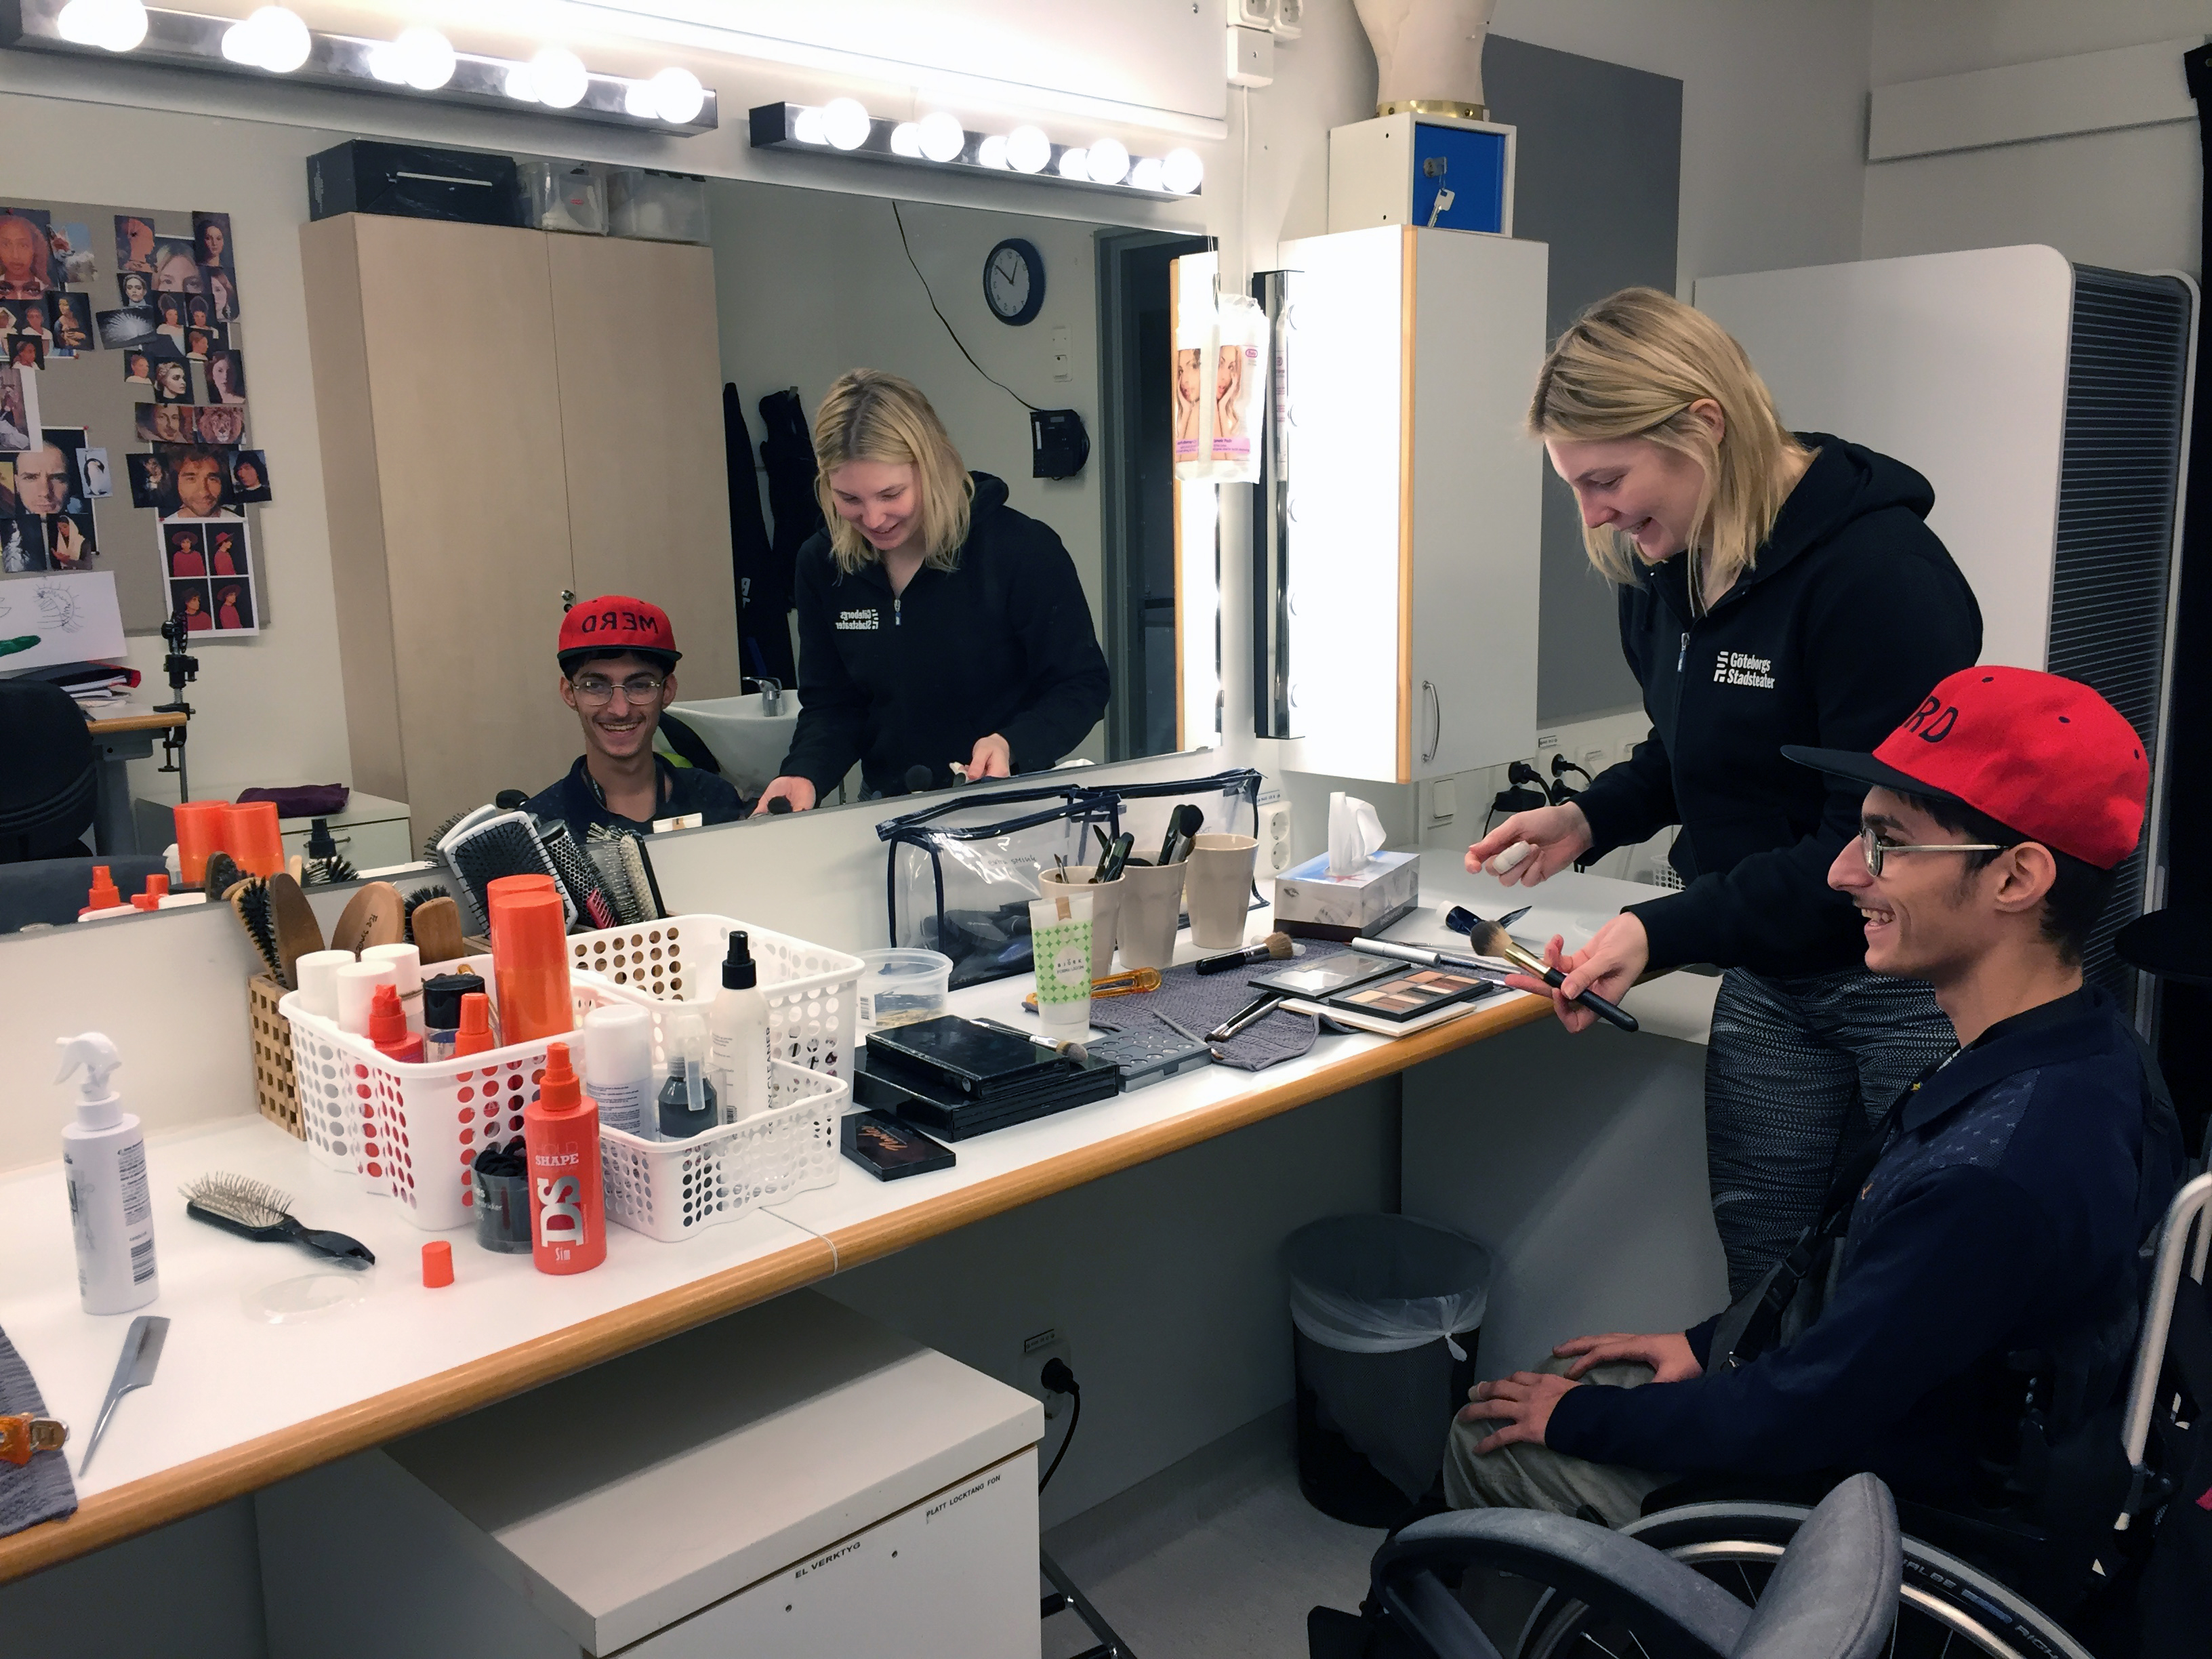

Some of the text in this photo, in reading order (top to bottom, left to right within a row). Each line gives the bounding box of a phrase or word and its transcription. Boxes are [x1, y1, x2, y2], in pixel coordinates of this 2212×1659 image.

[1730, 652, 1771, 674] Göteborgs
[1727, 668, 1776, 689] Stadsteater
[535, 1153, 579, 1166] SHAPE
[926, 1502, 947, 1518] PLATT
[795, 1542, 861, 1579] EL VERKTYG
